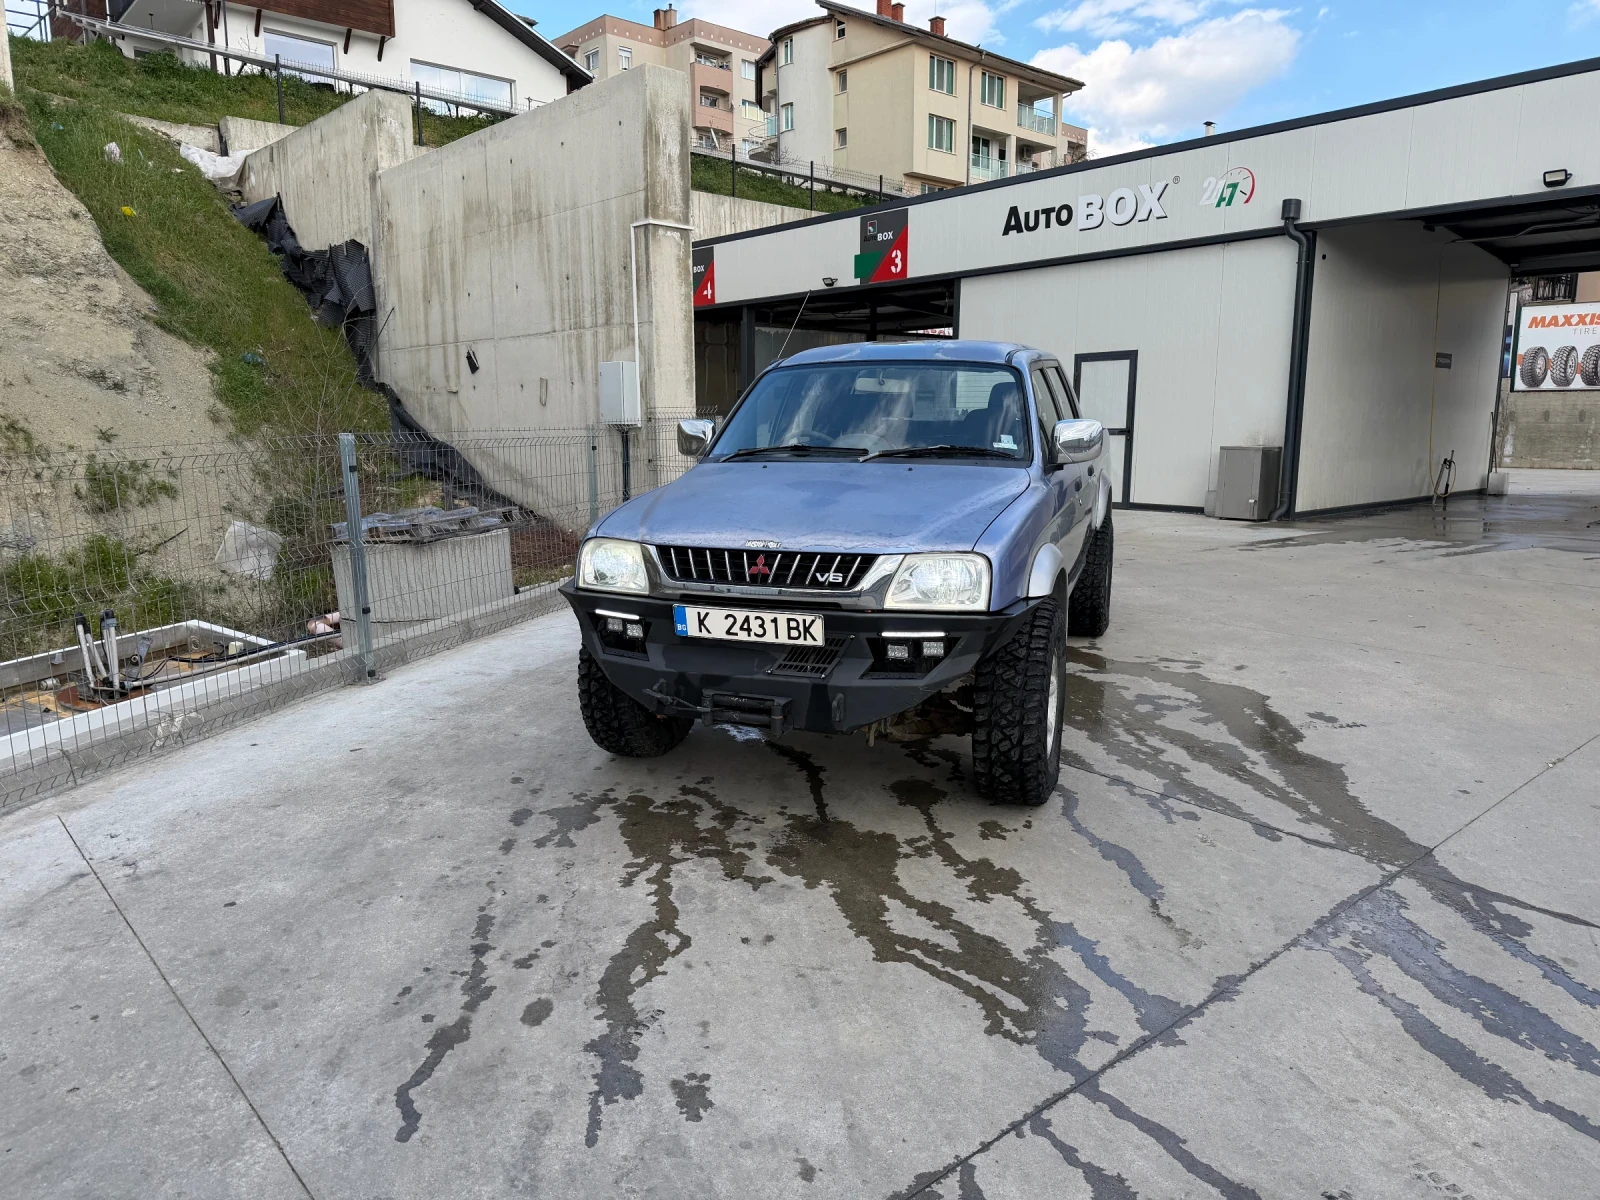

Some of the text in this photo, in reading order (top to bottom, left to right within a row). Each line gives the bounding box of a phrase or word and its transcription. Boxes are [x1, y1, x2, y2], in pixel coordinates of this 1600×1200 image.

[693, 265, 705, 273] BOX
[891, 249, 902, 274] 3
[703, 280, 712, 300] 4
[815, 572, 843, 583] V6
[697, 611, 818, 642] K 2431 BK
